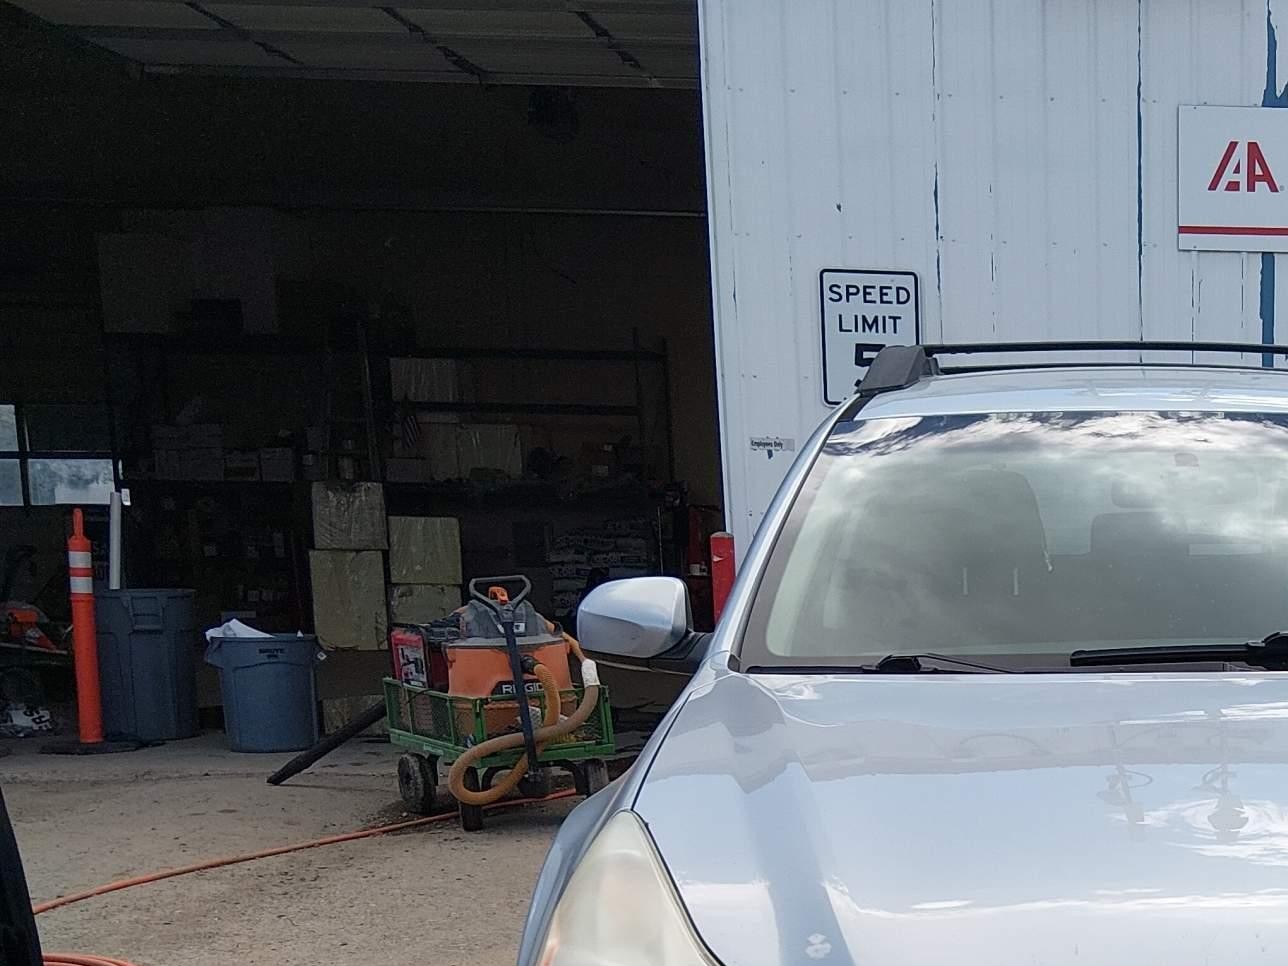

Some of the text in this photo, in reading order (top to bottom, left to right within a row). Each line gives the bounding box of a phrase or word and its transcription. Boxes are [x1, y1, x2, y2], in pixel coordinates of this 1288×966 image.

[828, 284, 911, 305] SPEED
[838, 314, 902, 334] LIMIT
[502, 682, 545, 694] RIGID
